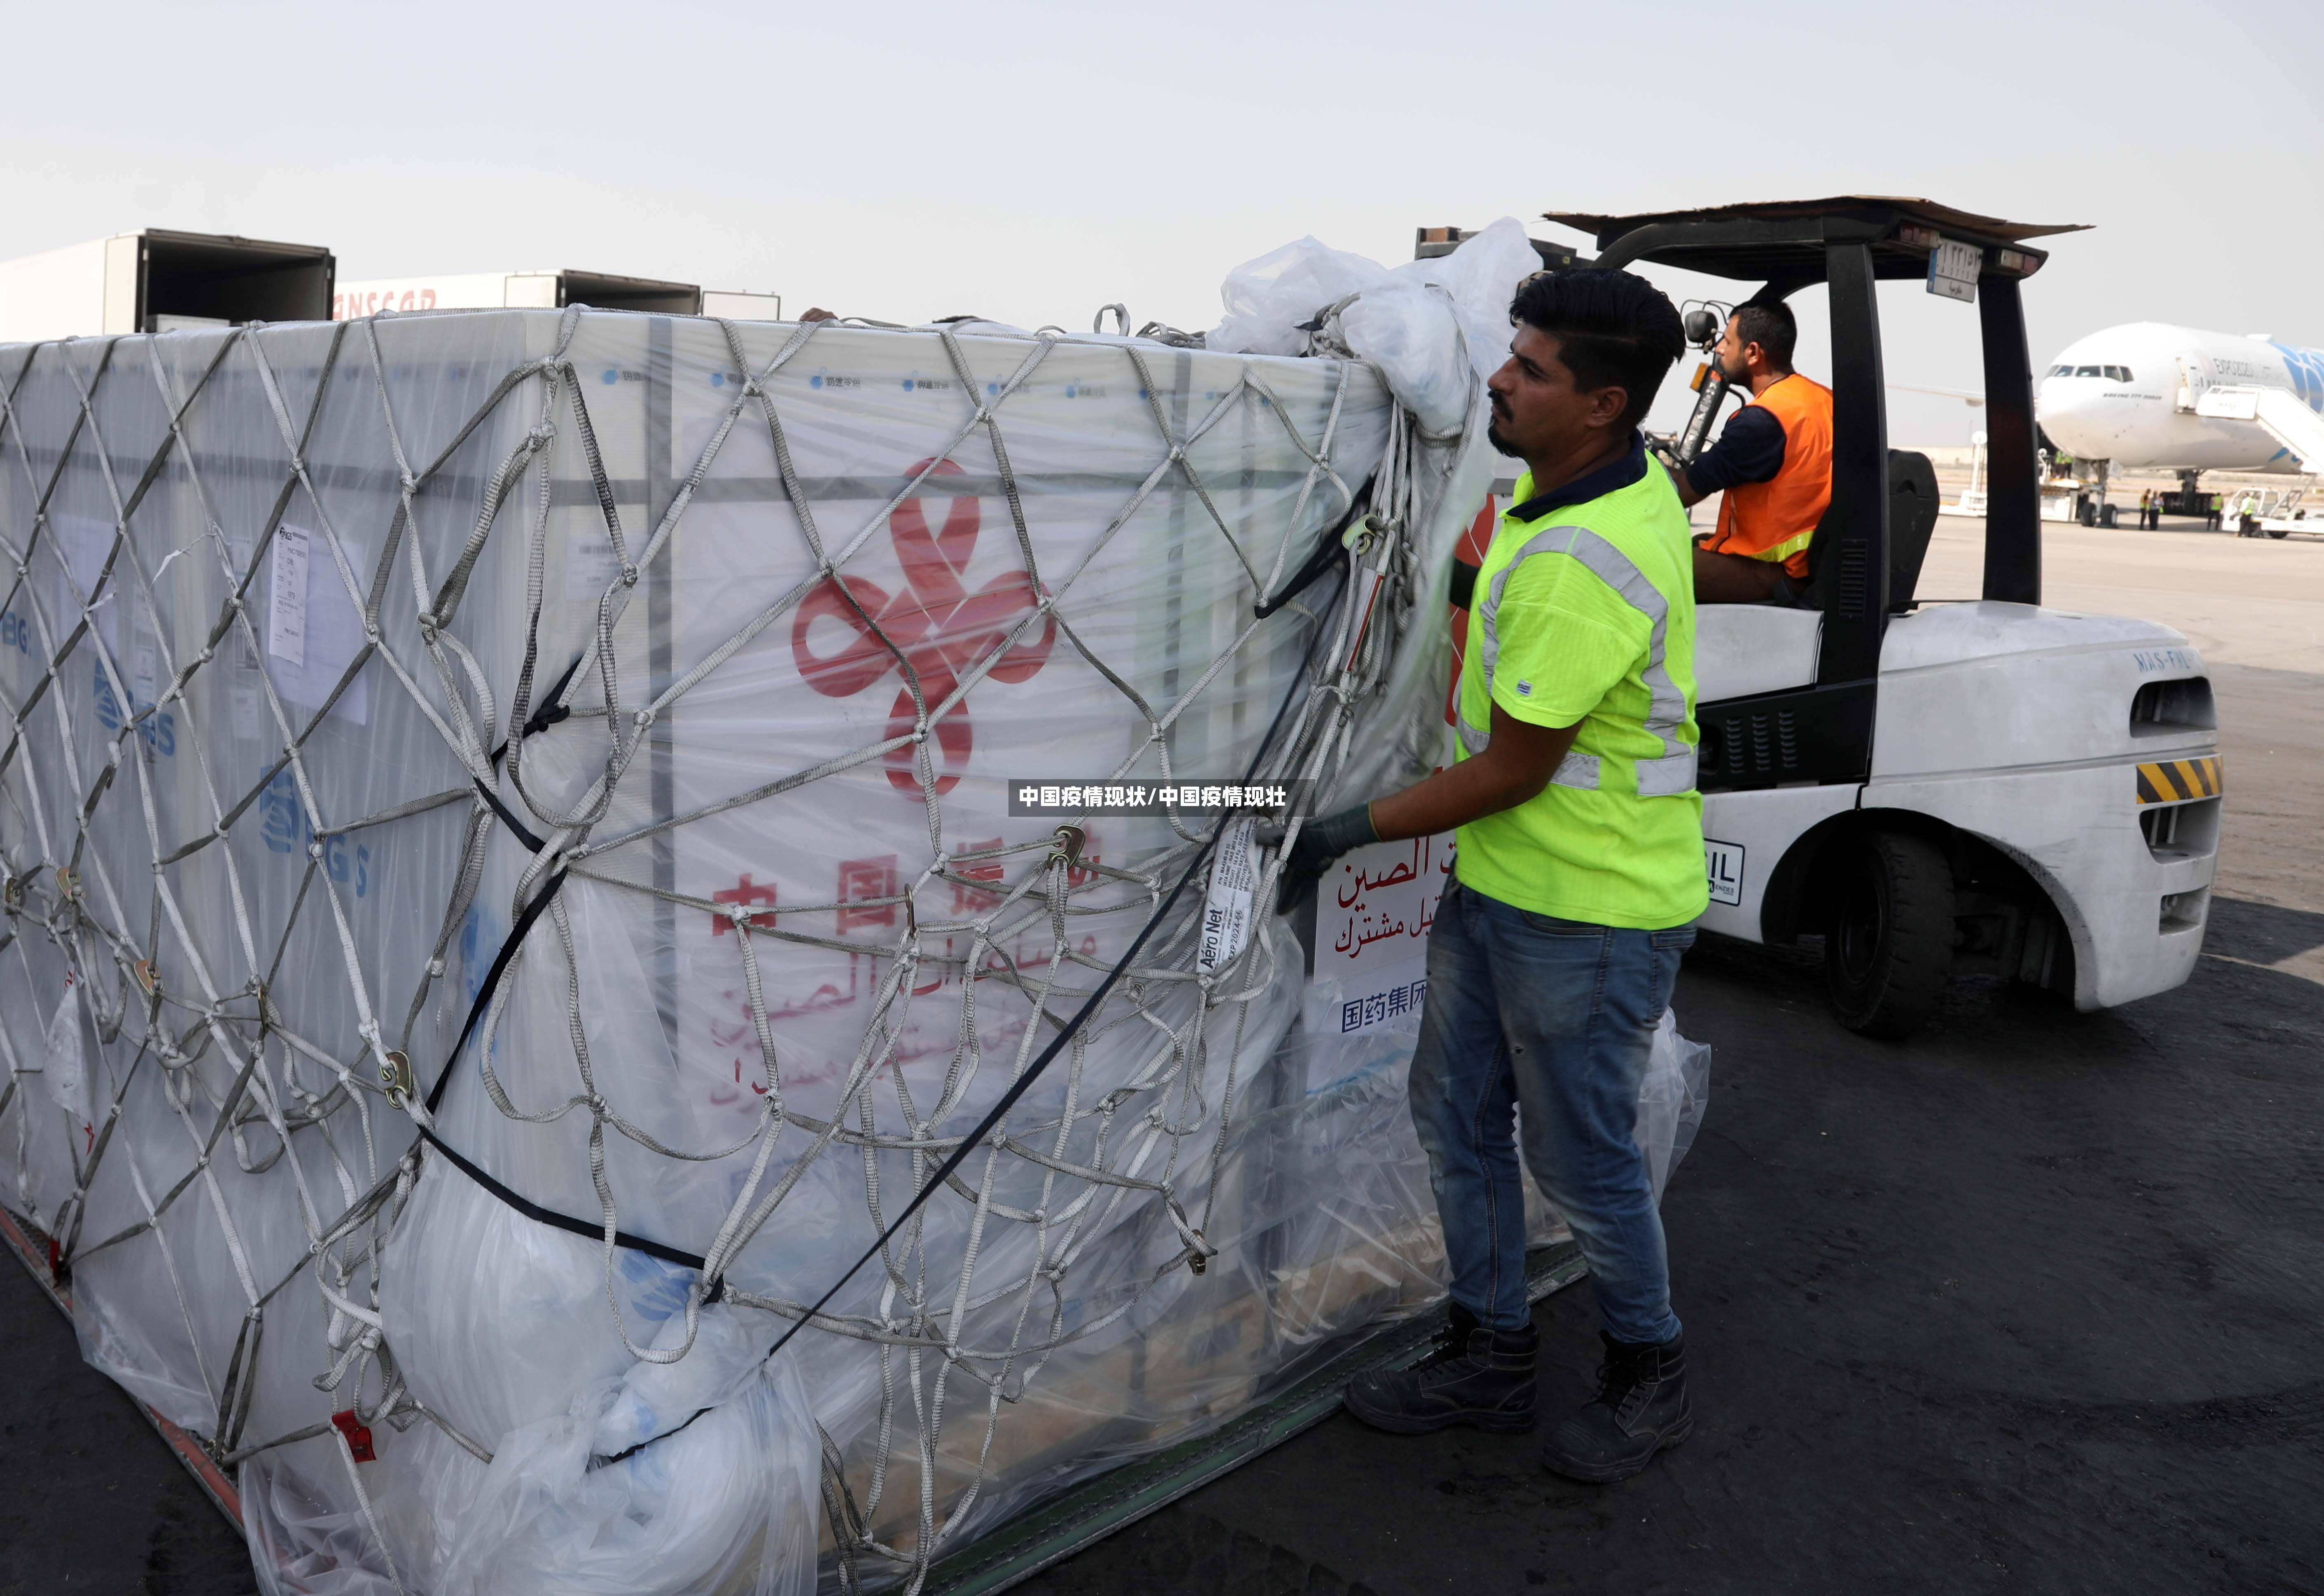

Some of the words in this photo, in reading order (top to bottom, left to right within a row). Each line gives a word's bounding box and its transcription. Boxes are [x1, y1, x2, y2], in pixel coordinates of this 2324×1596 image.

[1205, 908, 1223, 933] Net
[1335, 912, 1404, 959] مشترك
[1200, 936, 1218, 969] Aéro
[1341, 978, 1427, 1034] 国药集团
